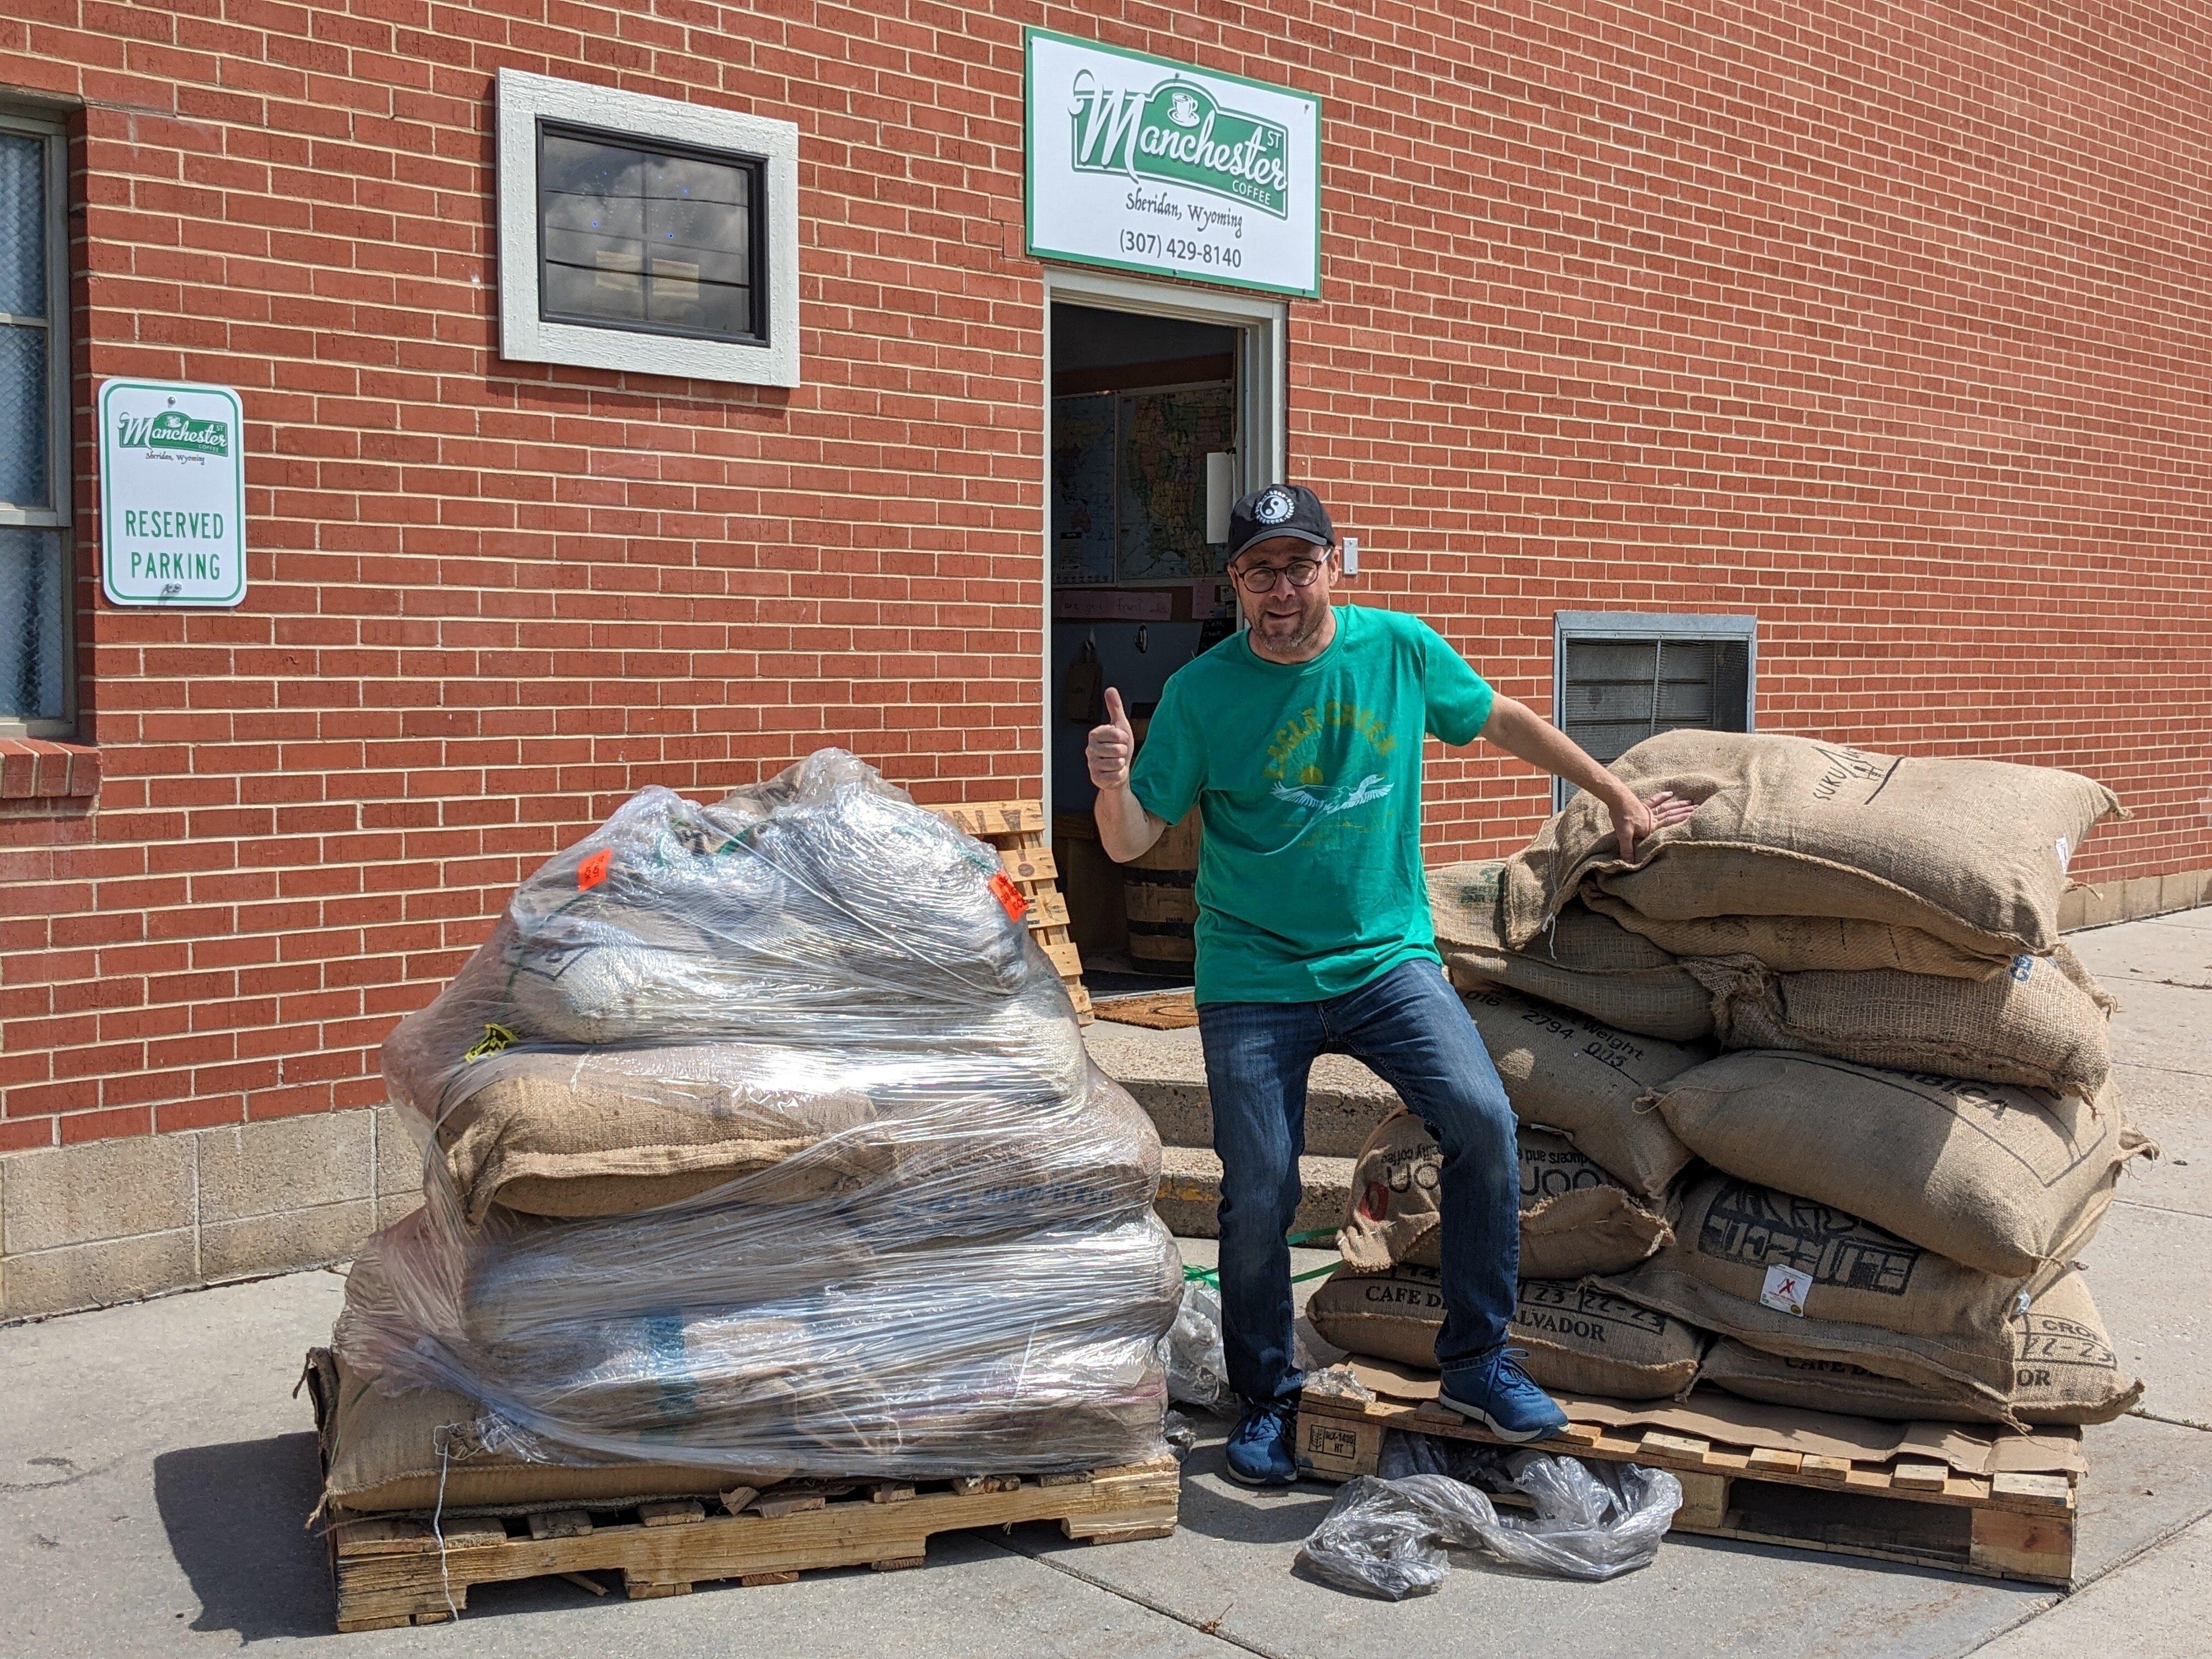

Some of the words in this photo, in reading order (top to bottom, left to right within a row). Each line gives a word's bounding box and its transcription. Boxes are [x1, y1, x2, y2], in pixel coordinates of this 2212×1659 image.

[1068, 69, 1287, 191] Manchester
[1267, 131, 1282, 149] ST
[1232, 180, 1271, 206] COFFEE
[1125, 188, 1182, 221] Sheridan,
[1187, 204, 1243, 239] Wyoming
[1120, 228, 1162, 258] (307)
[1166, 238, 1242, 268] 429-8140
[117, 412, 227, 449] Manchester
[176, 454, 205, 465] Wyoming
[199, 444, 219, 452] COFFEE
[125, 510, 224, 539] RESERVED
[131, 552, 220, 580] PARKING
[1521, 1010, 1575, 1040] 2794
[1366, 1285, 1421, 1305] CAFE
[1512, 1310, 1606, 1341] LVADOR
